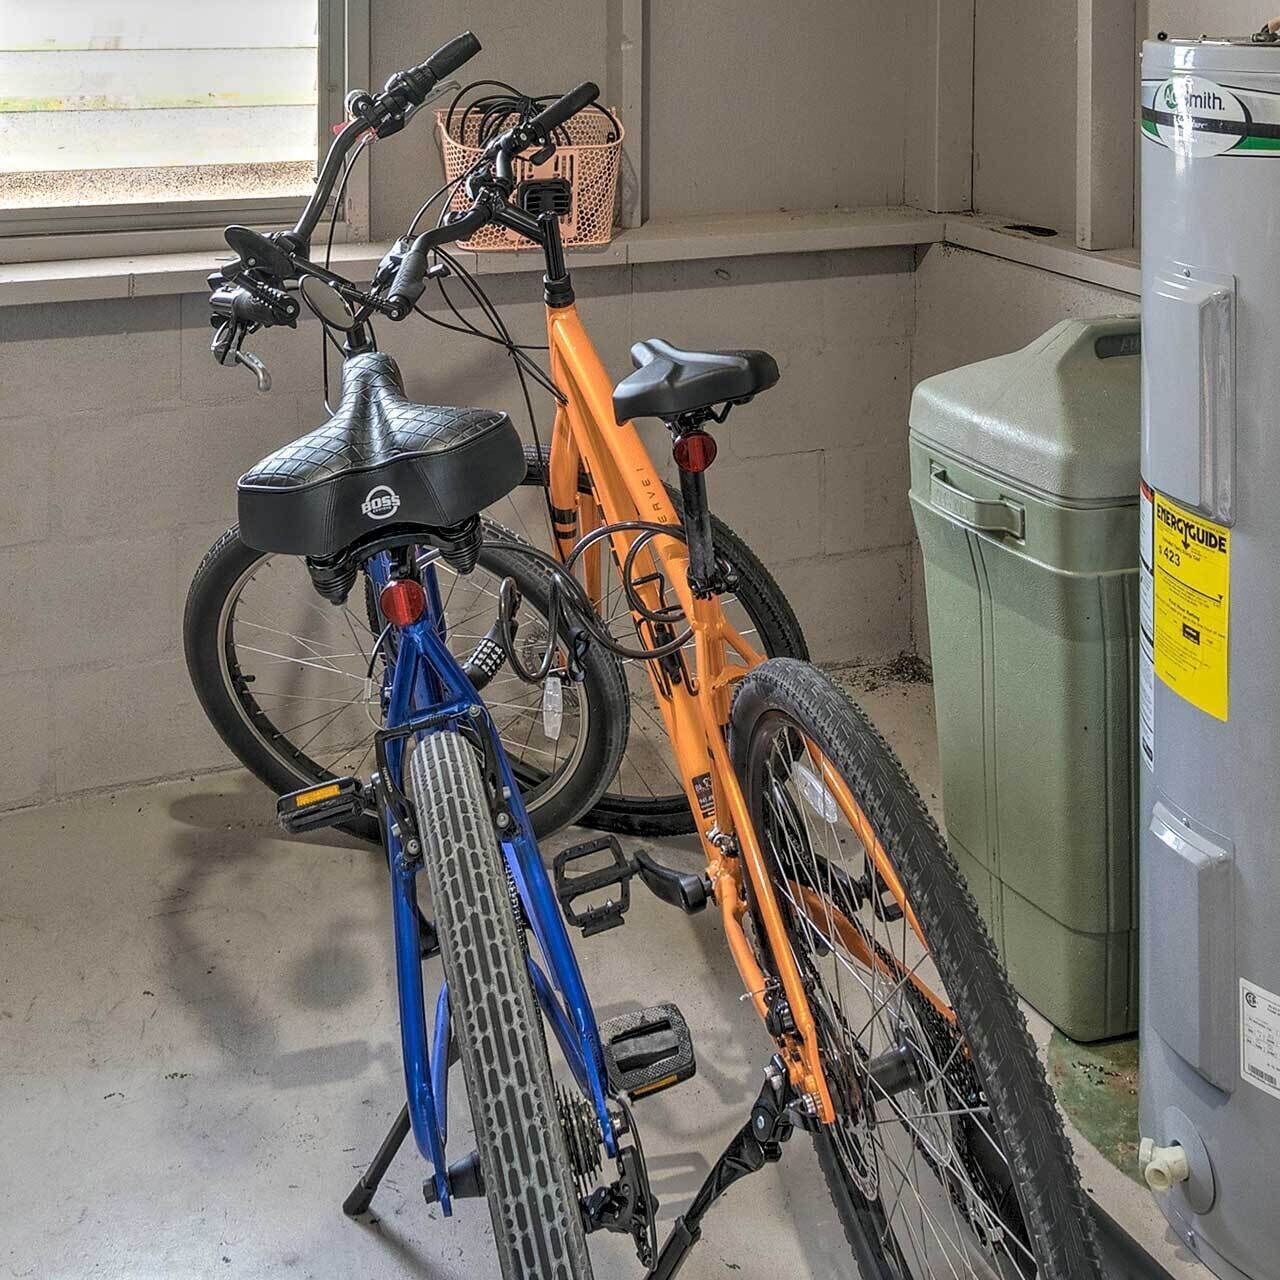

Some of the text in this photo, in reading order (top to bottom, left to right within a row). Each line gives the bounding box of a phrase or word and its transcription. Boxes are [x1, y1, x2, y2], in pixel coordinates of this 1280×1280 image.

[1183, 90, 1225, 111] mith.
[361, 495, 400, 515] BOSS
[1163, 546, 1181, 567] 423
